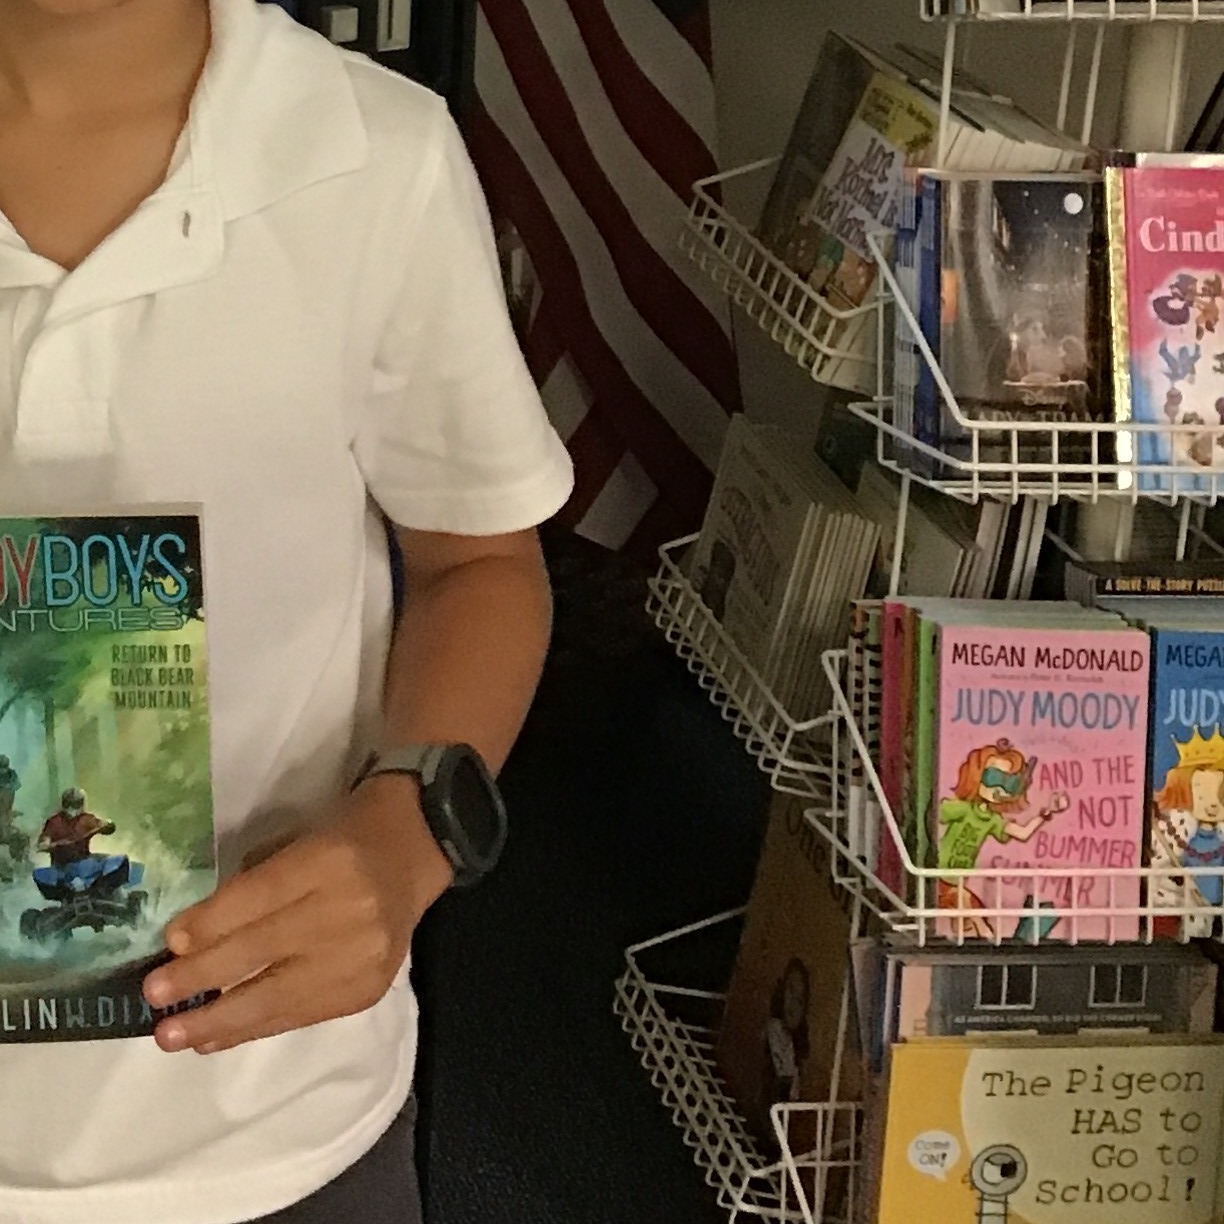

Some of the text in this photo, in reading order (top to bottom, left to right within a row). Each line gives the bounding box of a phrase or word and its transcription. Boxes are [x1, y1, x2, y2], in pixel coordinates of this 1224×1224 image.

[1139, 215, 1224, 252] Cind
[1017, 388, 1067, 409] Disney
[112, 644, 191, 663] RETURN TO
[952, 643, 1144, 672] MEGAN McDONALD
[1165, 644, 1224, 669] MEGA
[111, 667, 194, 686] BLACK BEAR
[115, 690, 191, 709] MOUNTAIN
[951, 688, 1141, 731] JUDY MOODY
[1040, 755, 1135, 792] AND THE
[1078, 795, 1134, 831] NOT
[1035, 830, 1137, 869] BUMMER
[982, 1064, 1205, 1100] The Pigeon
[1071, 1108, 1203, 1135] HAS to
[1092, 1143, 1199, 1169] Go to
